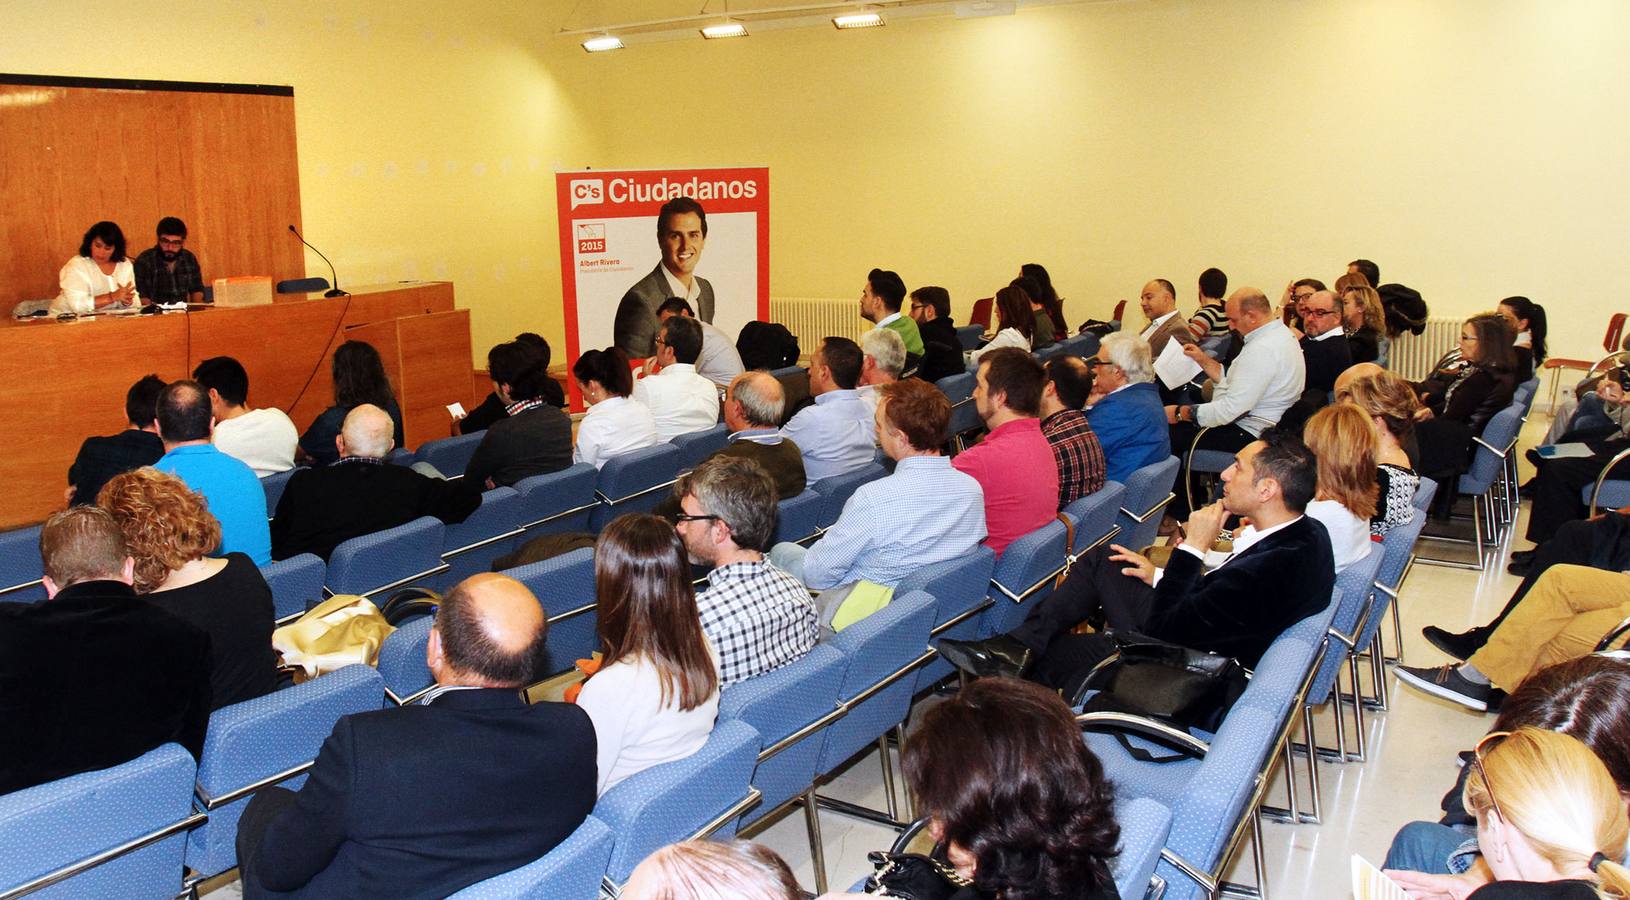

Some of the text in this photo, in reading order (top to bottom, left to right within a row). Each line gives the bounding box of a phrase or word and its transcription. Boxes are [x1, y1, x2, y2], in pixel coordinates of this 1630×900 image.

[574, 176, 758, 203] C's Ciudadanos
[581, 241, 603, 251] 2015
